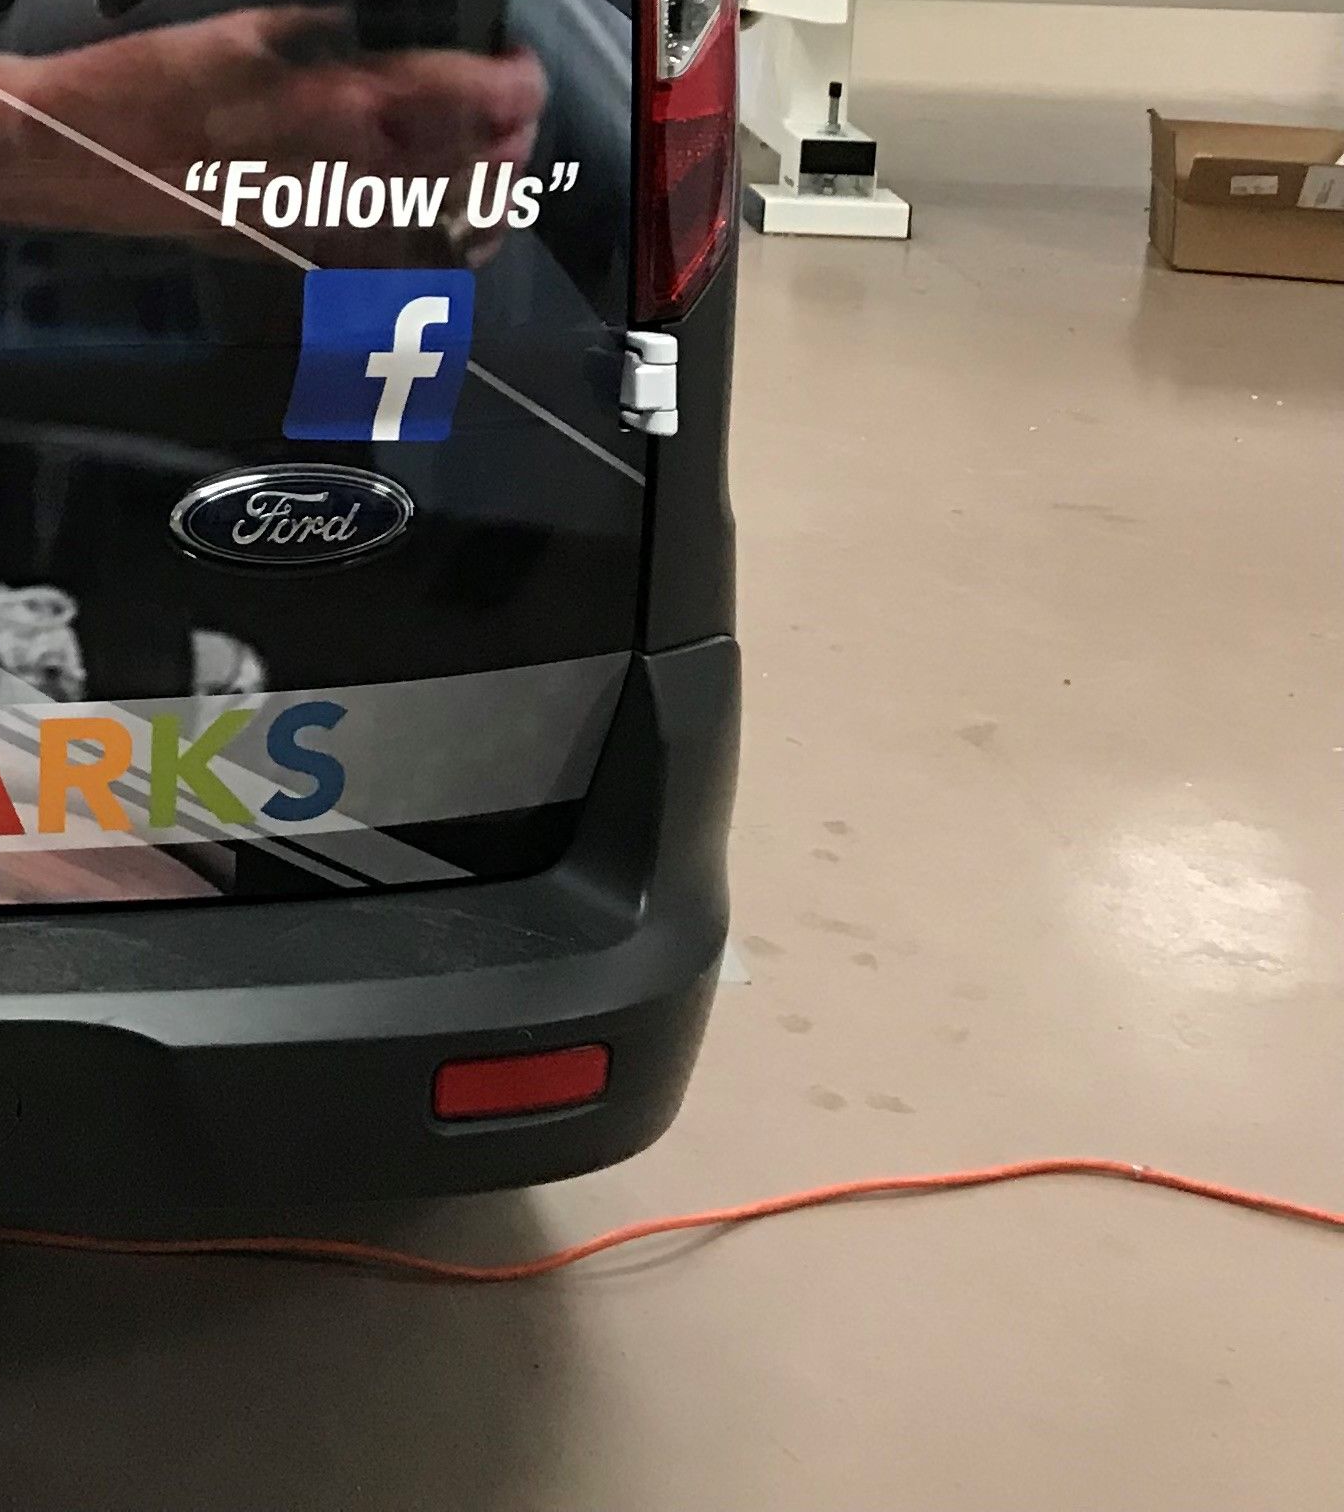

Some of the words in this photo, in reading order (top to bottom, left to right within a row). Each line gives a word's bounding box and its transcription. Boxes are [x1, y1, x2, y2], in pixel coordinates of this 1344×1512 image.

[184, 159, 451, 229] “Follow
[465, 160, 581, 230] Us”
[231, 489, 360, 547] Ford
